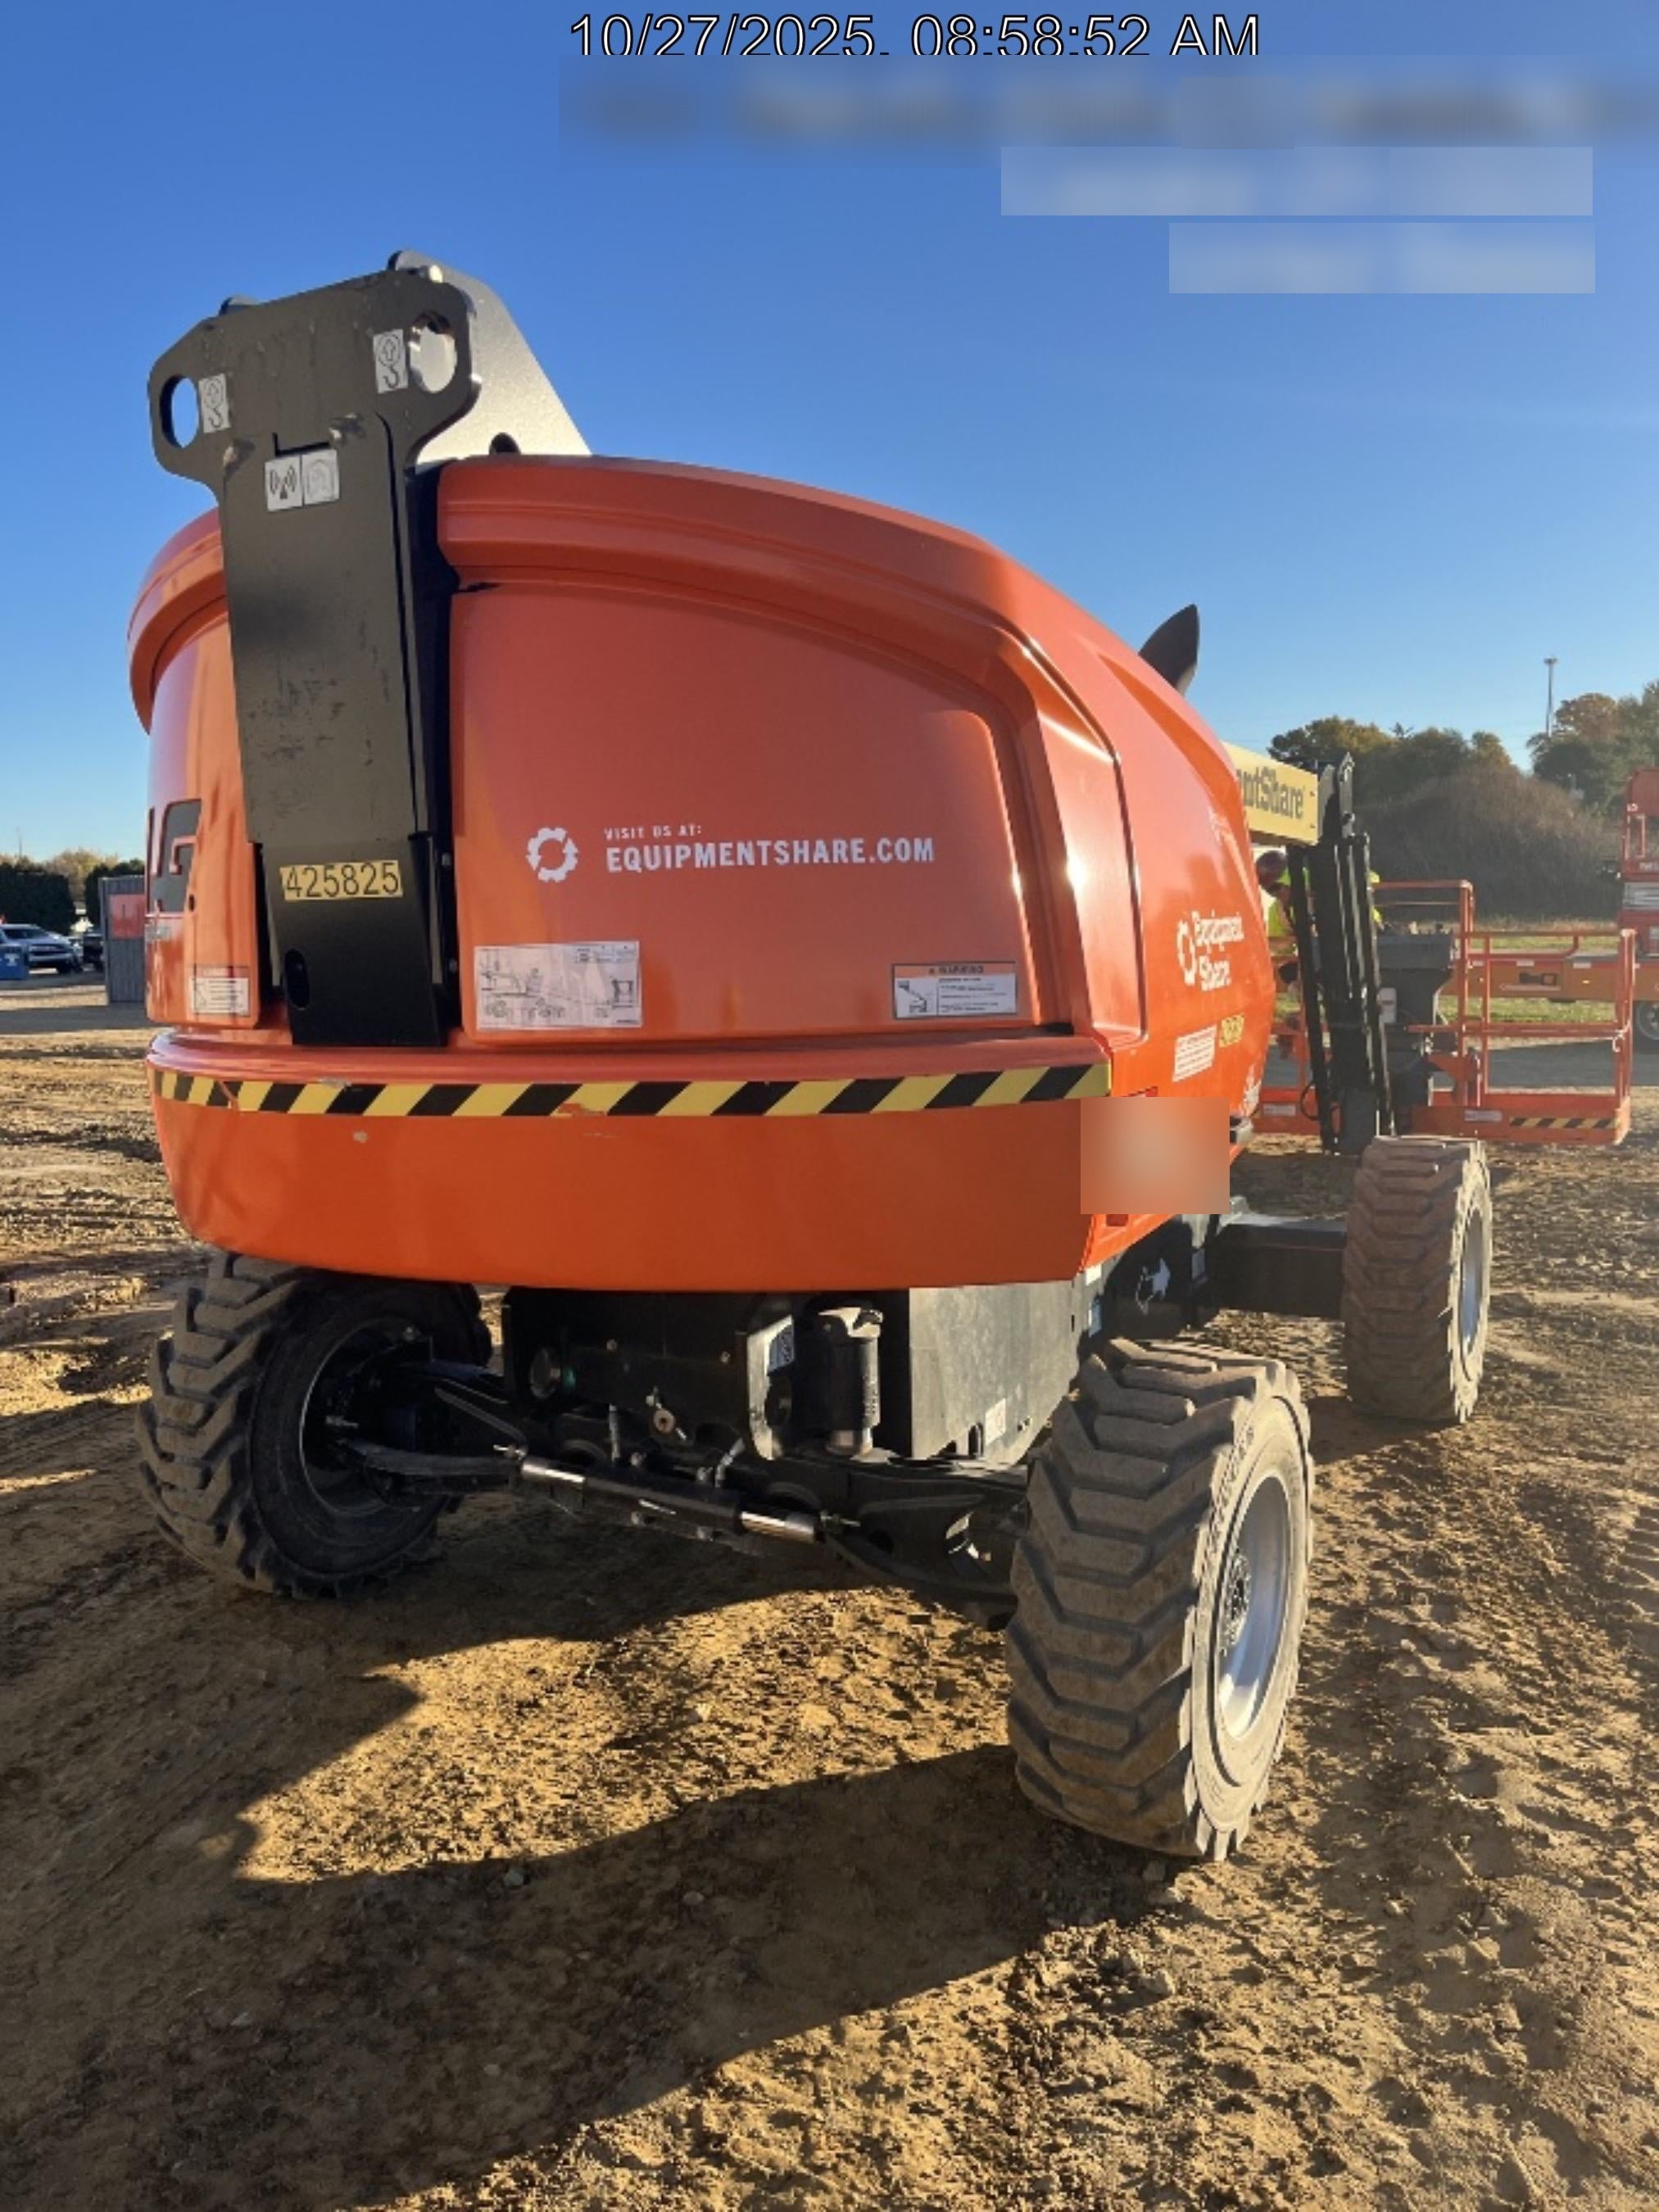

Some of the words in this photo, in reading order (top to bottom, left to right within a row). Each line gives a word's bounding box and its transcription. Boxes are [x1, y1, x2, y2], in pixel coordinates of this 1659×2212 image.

[605, 827, 645, 841] VISIT
[653, 825, 672, 837] US
[678, 824, 702, 836] AT:
[606, 836, 936, 873] EQUIPMENTSHARE.COM
[287, 862, 400, 898] 425825
